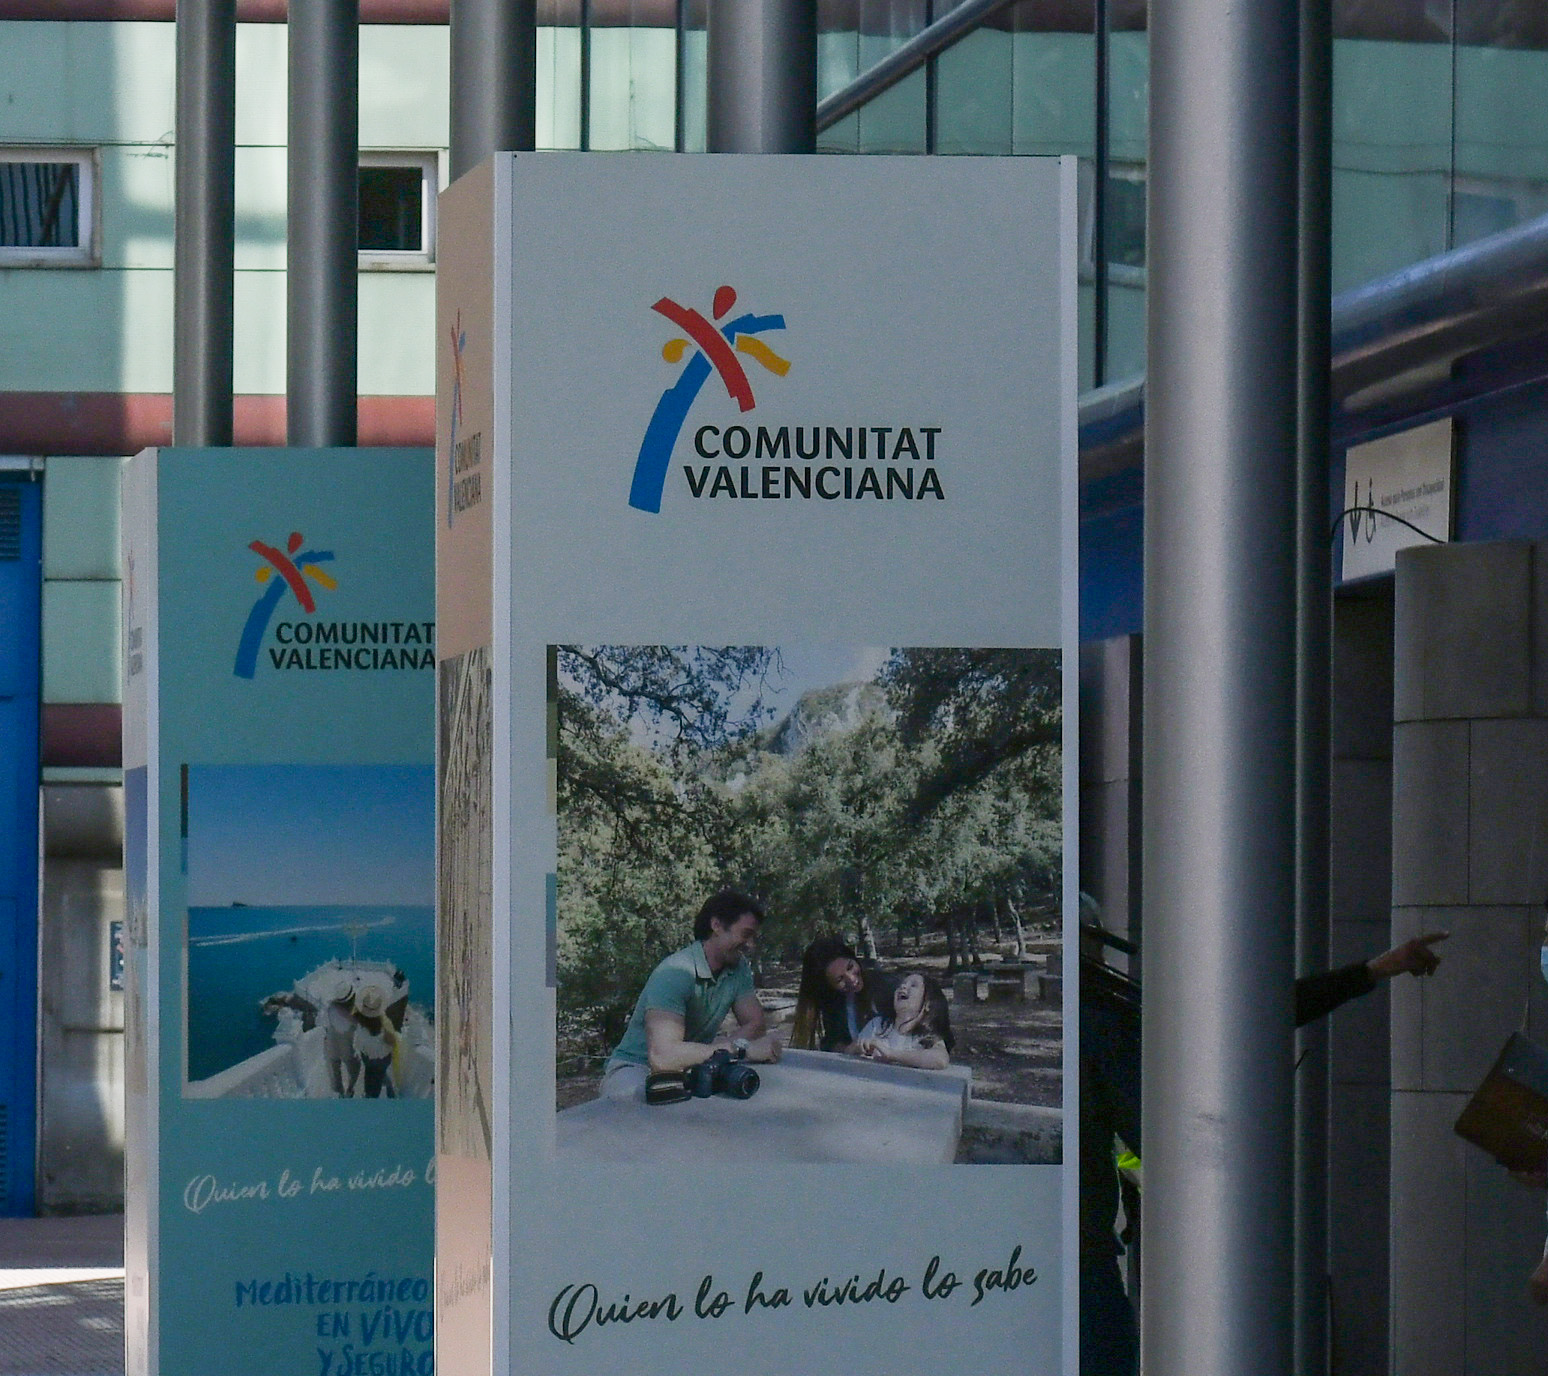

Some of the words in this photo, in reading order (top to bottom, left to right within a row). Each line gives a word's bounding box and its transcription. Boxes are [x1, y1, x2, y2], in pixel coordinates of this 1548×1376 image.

[694, 425, 942, 460] COMUNITAT
[683, 465, 945, 501] VALENCIANA
[275, 622, 435, 644] COMUNITAT
[269, 648, 435, 670] VALENCIANA
[184, 1174, 269, 1214] Quien
[278, 1169, 303, 1199] lo
[310, 1167, 340, 1195] ha
[348, 1165, 416, 1190] vivido
[424, 1155, 435, 1185] l
[235, 1271, 428, 1307] Mediterráneo
[548, 1283, 684, 1345] Quien
[695, 1275, 735, 1319] lo
[745, 1271, 792, 1314] ha
[804, 1269, 910, 1308] vivido
[921, 1256, 963, 1301] lo
[971, 1245, 1038, 1305] sabe
[316, 1310, 350, 1339] EN
